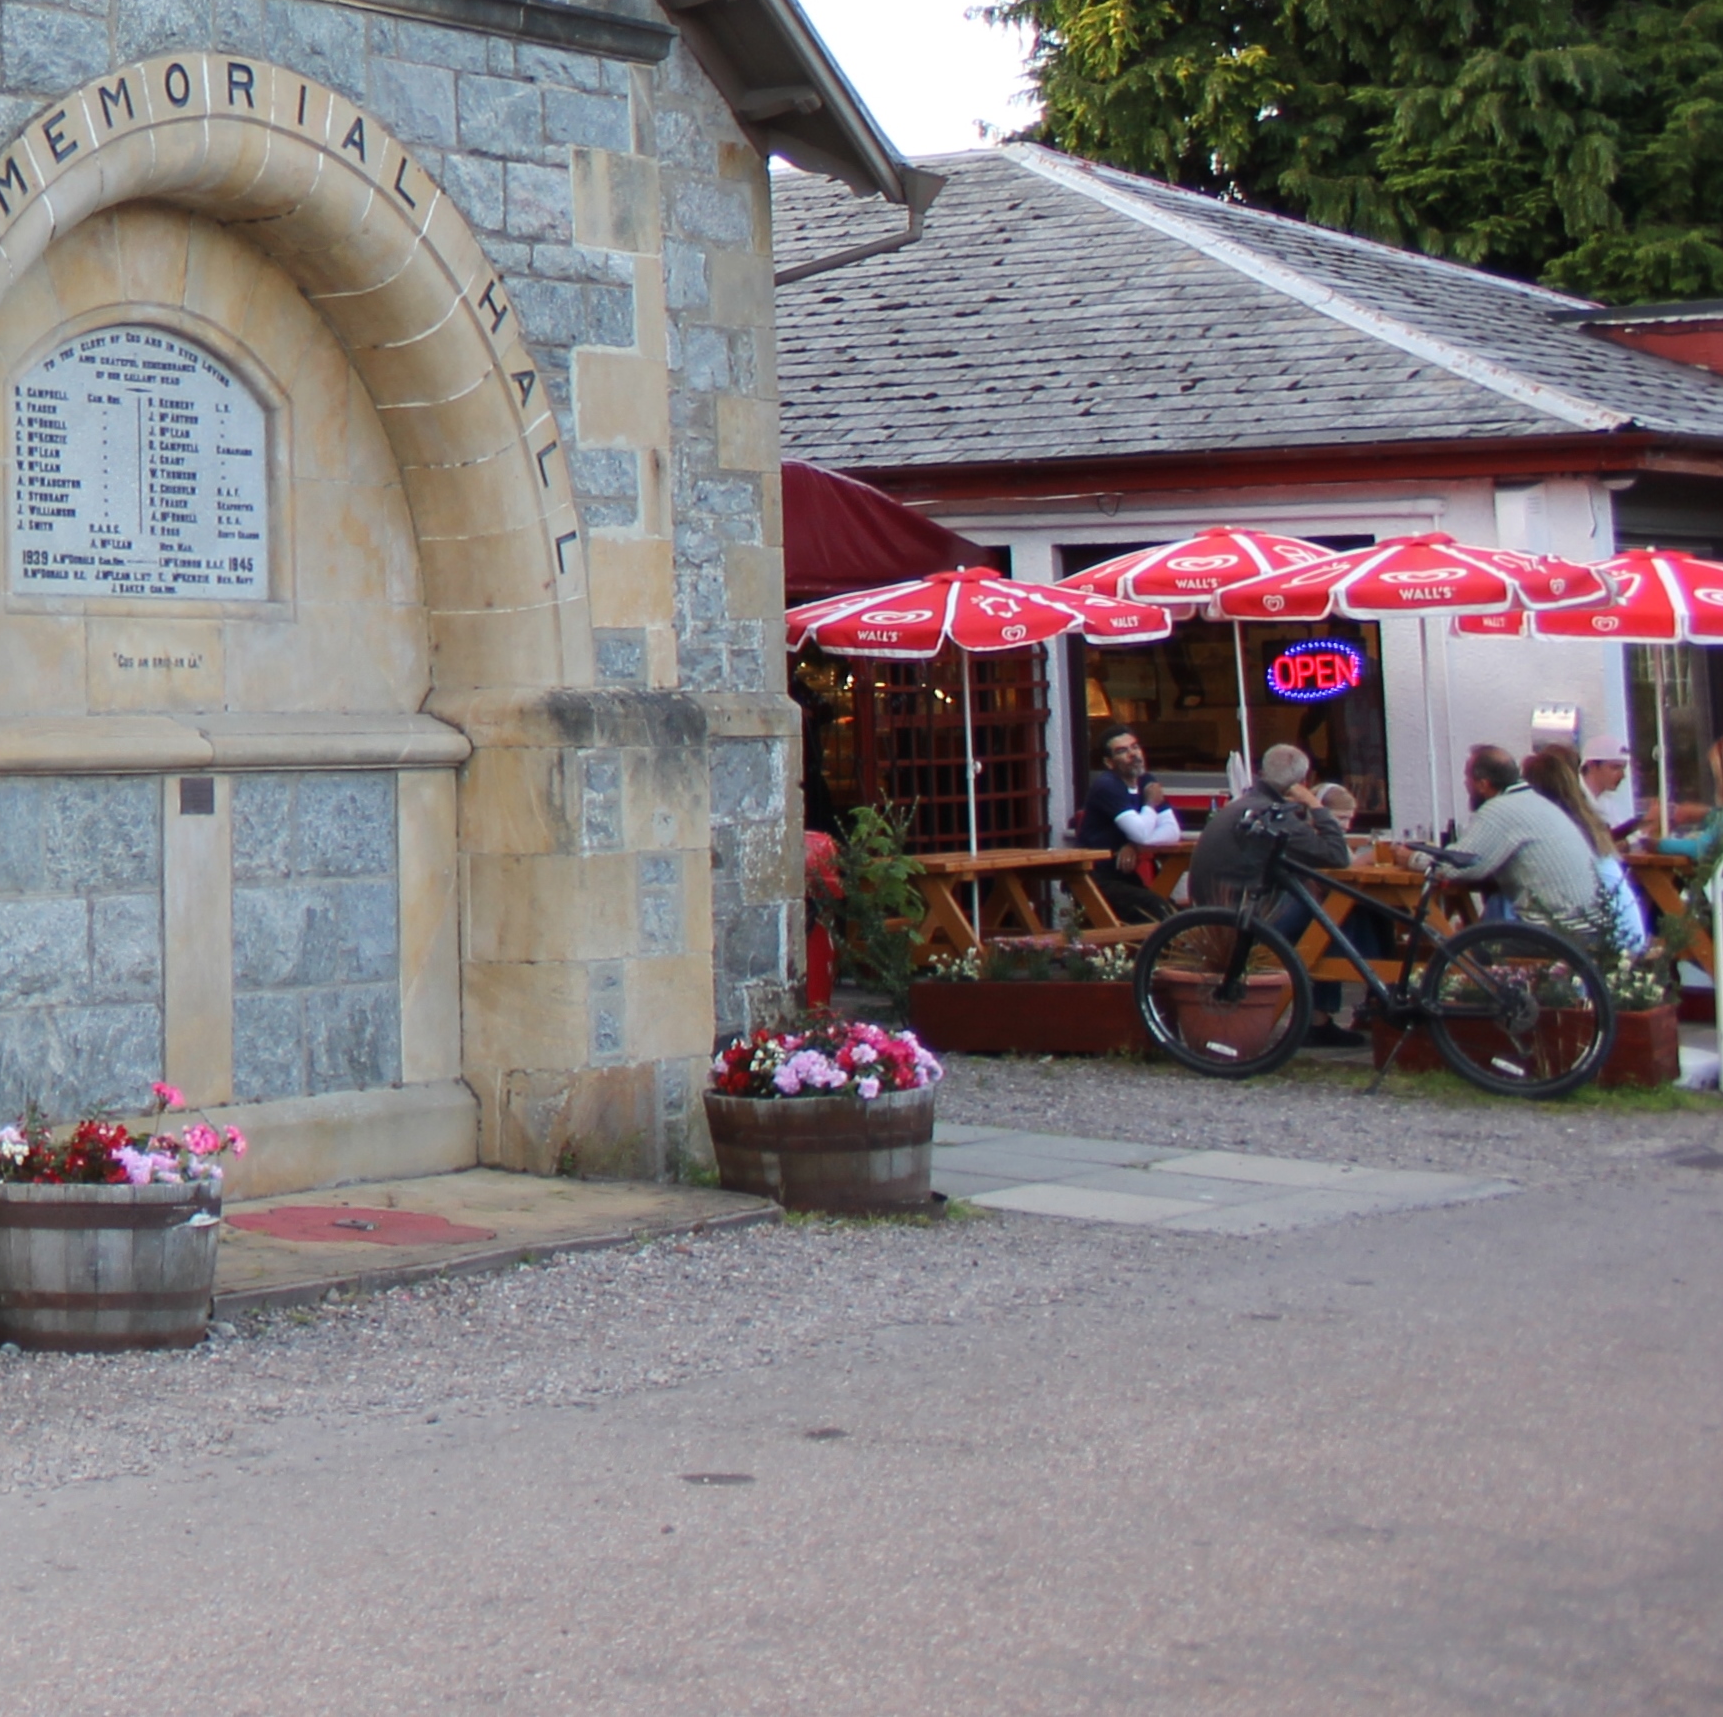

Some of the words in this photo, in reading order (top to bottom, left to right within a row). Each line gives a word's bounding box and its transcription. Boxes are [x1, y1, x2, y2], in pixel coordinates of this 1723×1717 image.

[59, 347, 75, 362] THE
[475, 278, 580, 575] HALL
[23, 550, 48, 565] 1939
[228, 556, 253, 572] 1945
[1176, 577, 1218, 589] WALL'S
[1399, 586, 1453, 600] WALL'S
[1110, 615, 1139, 629] WALL'S
[857, 629, 898, 643] WALL'S
[1273, 653, 1360, 689] OPEN
